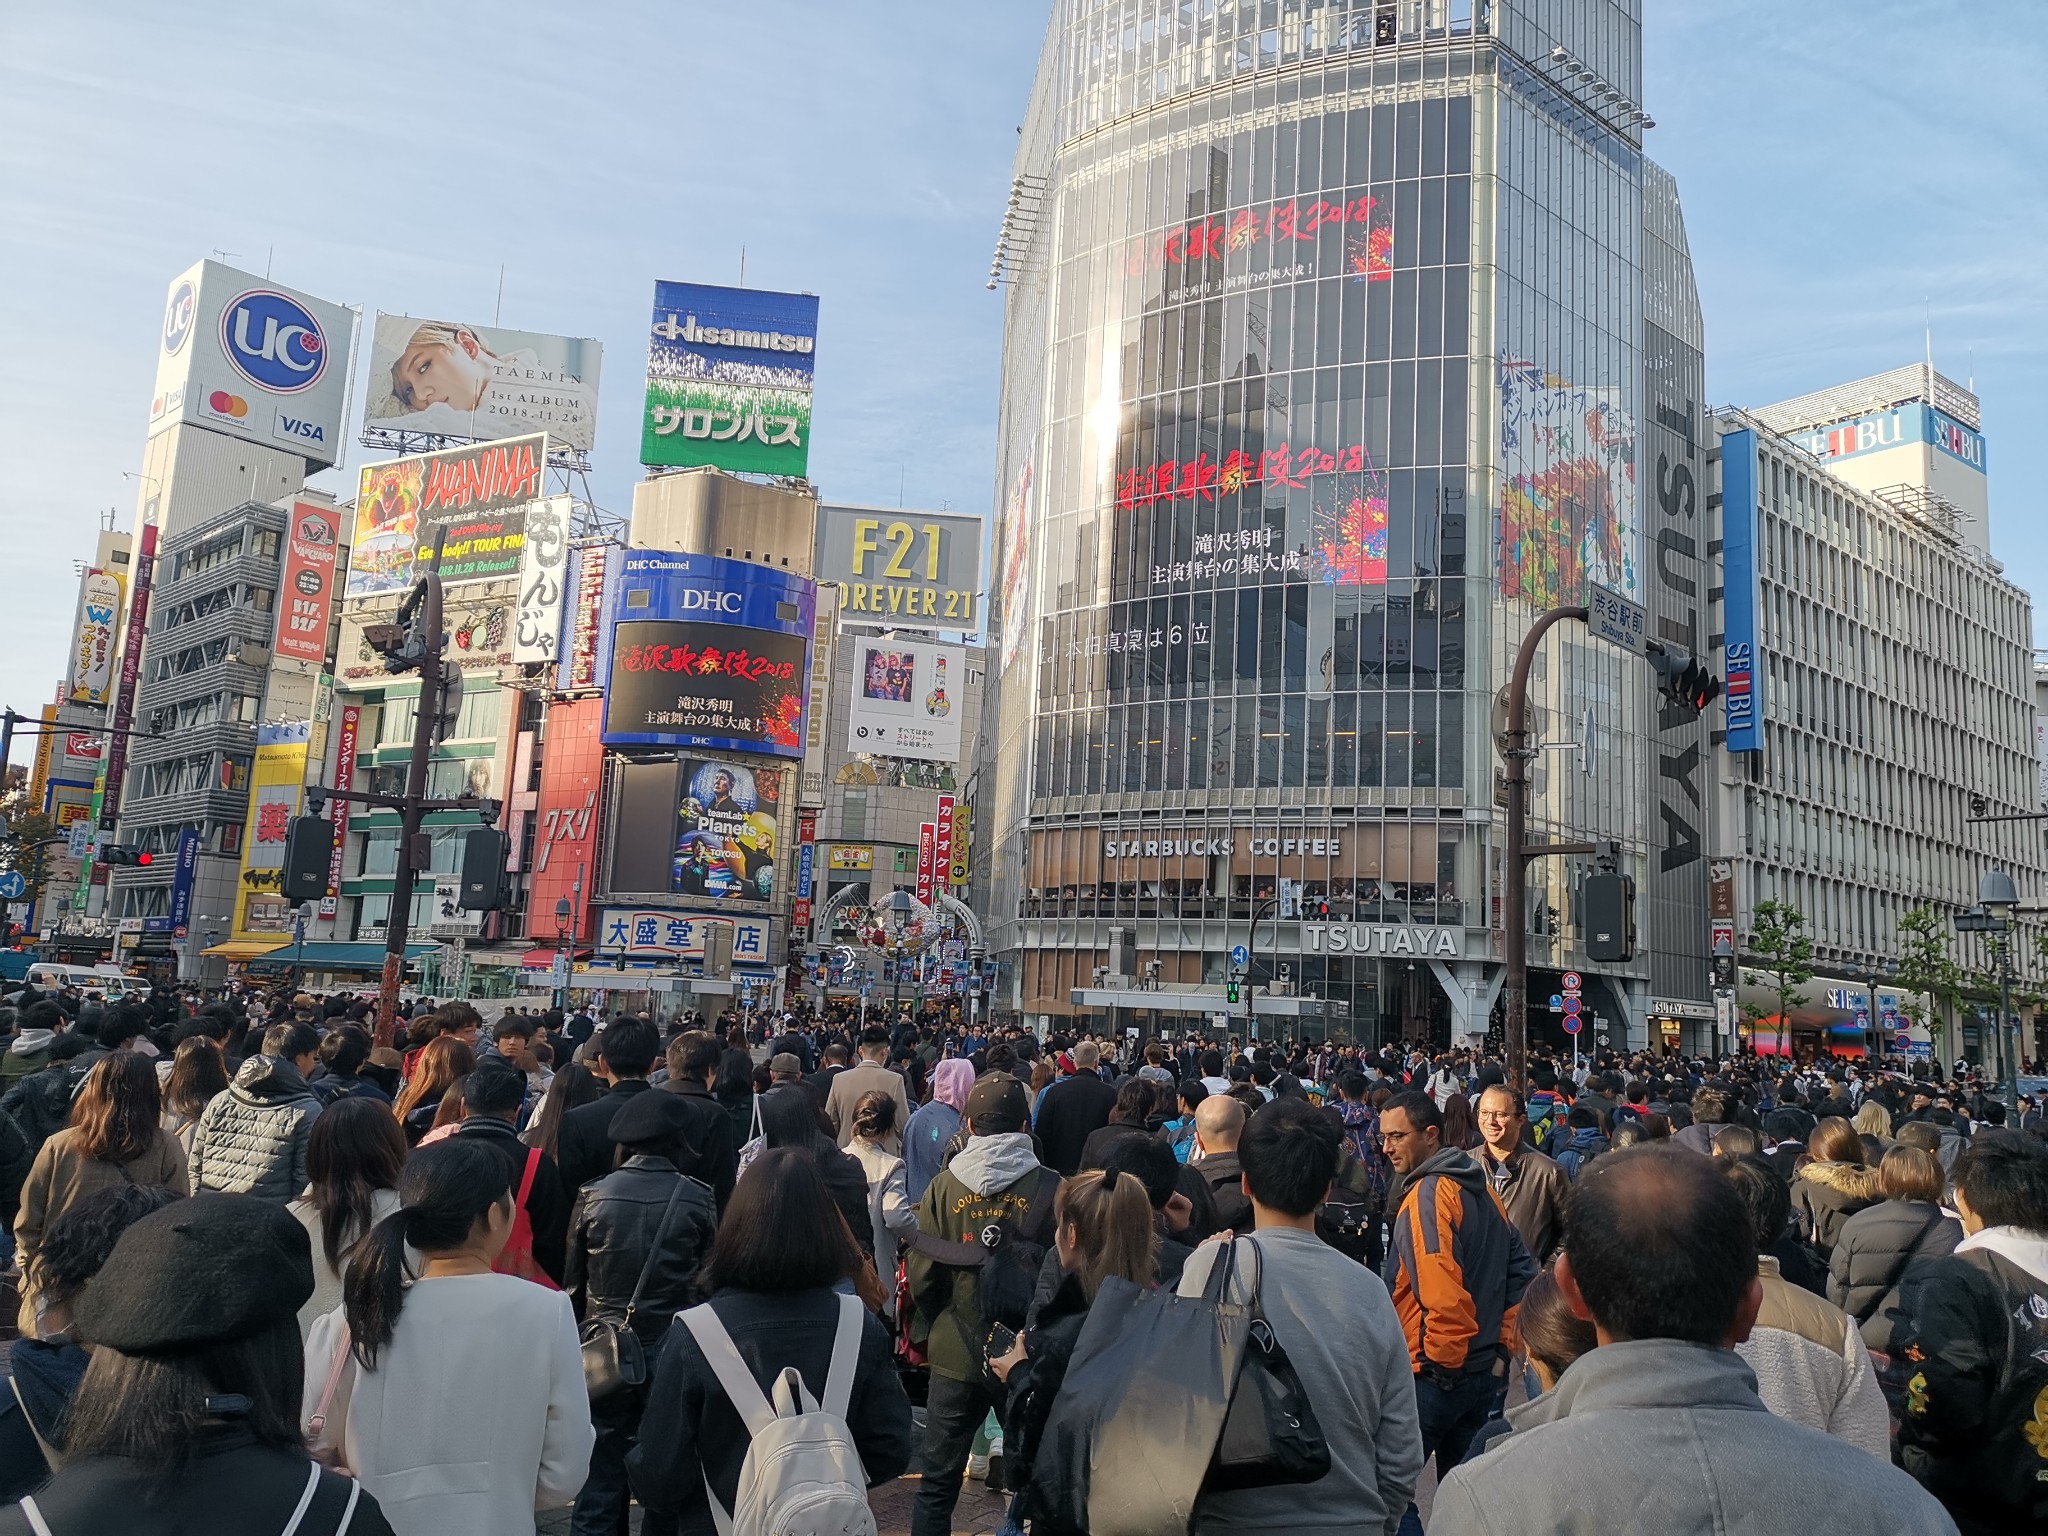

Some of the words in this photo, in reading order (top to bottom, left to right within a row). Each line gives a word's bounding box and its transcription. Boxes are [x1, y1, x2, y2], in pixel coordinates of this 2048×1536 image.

[652, 314, 813, 354] Hisamitsu
[493, 365, 582, 384] TAEMIN
[491, 390, 512, 401] 1st
[517, 393, 580, 409] ALBUM
[208, 411, 246, 426] mastercard
[489, 404, 579, 423] 2018.11.28
[279, 415, 325, 442] VISA
[652, 404, 801, 447] サロンパス
[1795, 413, 1905, 459] SEIBU
[1934, 415, 1983, 468] SEIBU
[422, 445, 541, 511] WANIMA
[418, 541, 470, 560] Evebody!!
[473, 537, 502, 552] TOUR
[503, 533, 528, 550] FINA
[852, 518, 940, 580] F21
[1195, 527, 1272, 555] 滝沢秀明
[438, 561, 474, 577] 018.11.28
[476, 558, 515, 573] Release!!
[627, 560, 648, 570] DHC
[649, 559, 689, 570] Channel
[517, 500, 565, 657] もんじゃ
[293, 598, 320, 616] B1F
[681, 588, 742, 613] DHC
[839, 581, 937, 616] OREVER
[944, 590, 971, 619] 21
[290, 614, 319, 632] B2F
[1593, 591, 1644, 634] 渋谷駅前
[1601, 621, 1625, 642] Shibuya
[1624, 630, 1637, 646] Sta.
[618, 644, 795, 682] 滝沢歌舞伎2018
[1726, 641, 1753, 732] SEIBU
[677, 696, 733, 713] 滝沢秀明
[643, 711, 761, 732] 主演舞台の集大成！
[897, 727, 934, 737] すべてはあの
[692, 737, 710, 745] DHC
[896, 740, 934, 749] から始まった
[897, 733, 927, 742] ストリート
[258, 751, 291, 761] Matsumoto
[333, 732, 353, 837] ウィンターフルツギフト
[257, 802, 289, 843] 薬
[707, 808, 743, 821] teamLab
[698, 816, 757, 837] Planets
[936, 805, 952, 868] カラオケ
[714, 834, 740, 843] TOKYO
[1106, 838, 1234, 858] STARBUCKS
[1249, 838, 1341, 857] COFFEE
[711, 849, 742, 860] TOYOSU
[953, 867, 964, 876] 4F
[704, 879, 742, 892] DMM.com
[795, 903, 809, 925] 焼肉
[607, 917, 763, 953] 大盛堂店
[1306, 924, 1458, 955] TSUTAYA
[1652, 1001, 1685, 1015] TSUTAYA
[951, 1194, 983, 1214] LOVE
[970, 1209, 983, 1219] Be
